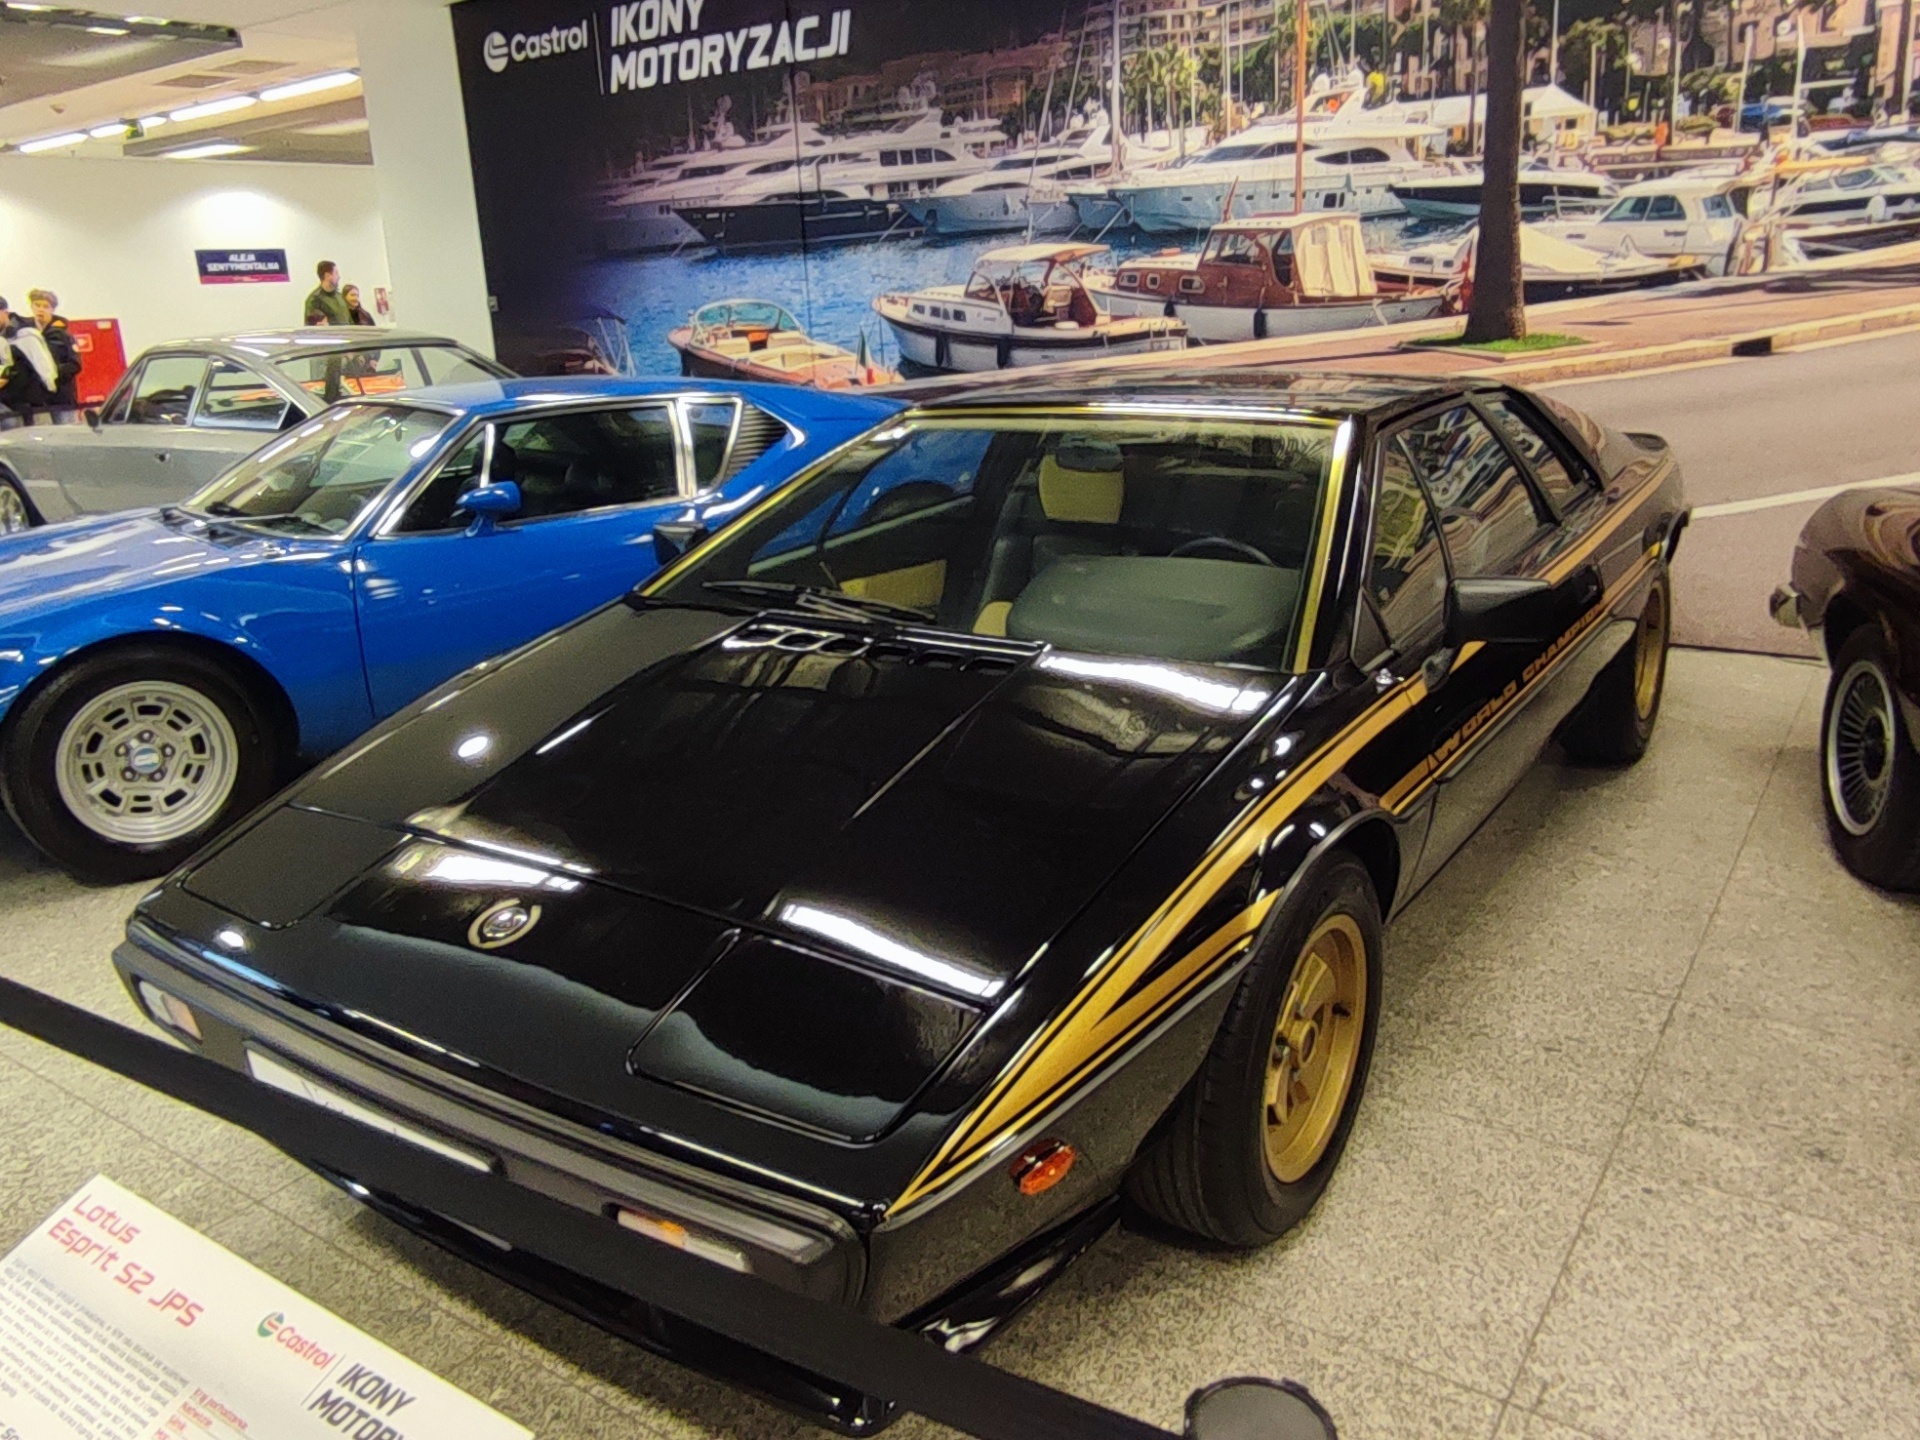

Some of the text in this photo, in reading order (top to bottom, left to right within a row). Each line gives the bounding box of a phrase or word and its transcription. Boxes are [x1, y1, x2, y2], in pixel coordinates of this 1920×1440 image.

[511, 19, 588, 62] Castrol
[611, 0, 704, 48] IKONY
[610, 9, 852, 94] MOTORYZACJI
[1434, 679, 1517, 762] WORLD
[73, 1194, 141, 1244] Lotus
[48, 1217, 205, 1327] Esprit S2 JPS
[276, 1326, 337, 1370] Castrol
[307, 1388, 404, 1440] MOTOR
[336, 1363, 417, 1416] IKONY
